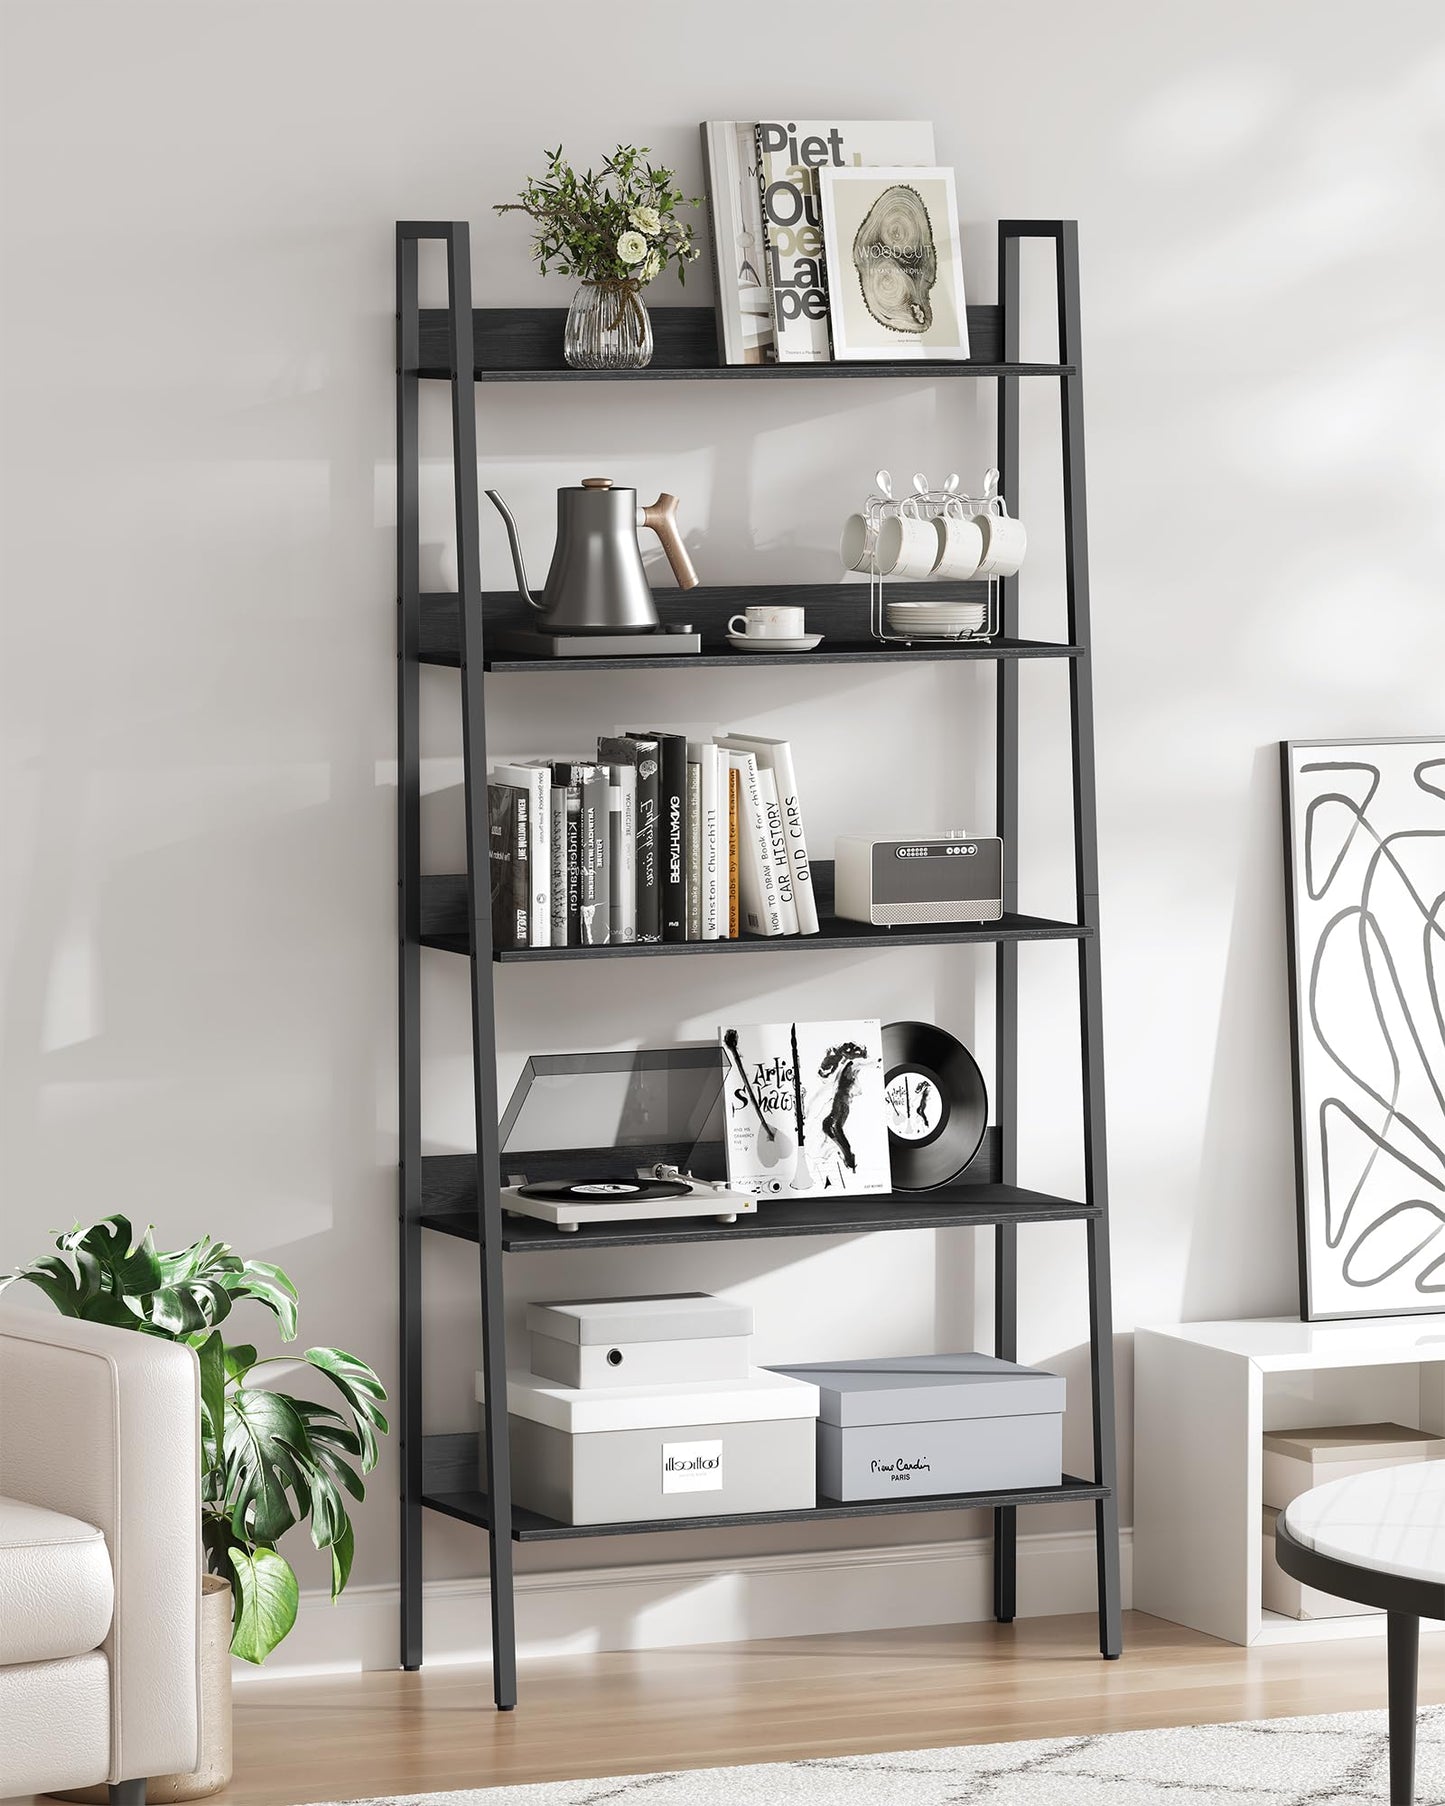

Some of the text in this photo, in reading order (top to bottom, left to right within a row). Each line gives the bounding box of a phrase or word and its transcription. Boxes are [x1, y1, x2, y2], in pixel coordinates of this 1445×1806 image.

[759, 123, 846, 167] Piet
[857, 244, 933, 259] WOODCUT
[690, 767, 698, 790] house
[691, 809, 698, 819] in
[691, 822, 700, 870] arrangement
[746, 758, 780, 931] HOW TO DRAW Book for children
[766, 801, 793, 903] CAR HISTORY
[785, 796, 810, 881] OLD CARS
[691, 873, 698, 882] an
[708, 808, 717, 931] Winston Churchill
[729, 861, 737, 872] by
[691, 907, 698, 916] to
[691, 919, 699, 934] How
[752, 1056, 796, 1089] Artie
[731, 1085, 797, 1117] Shaw
[891, 1474, 911, 1482] PARIS
